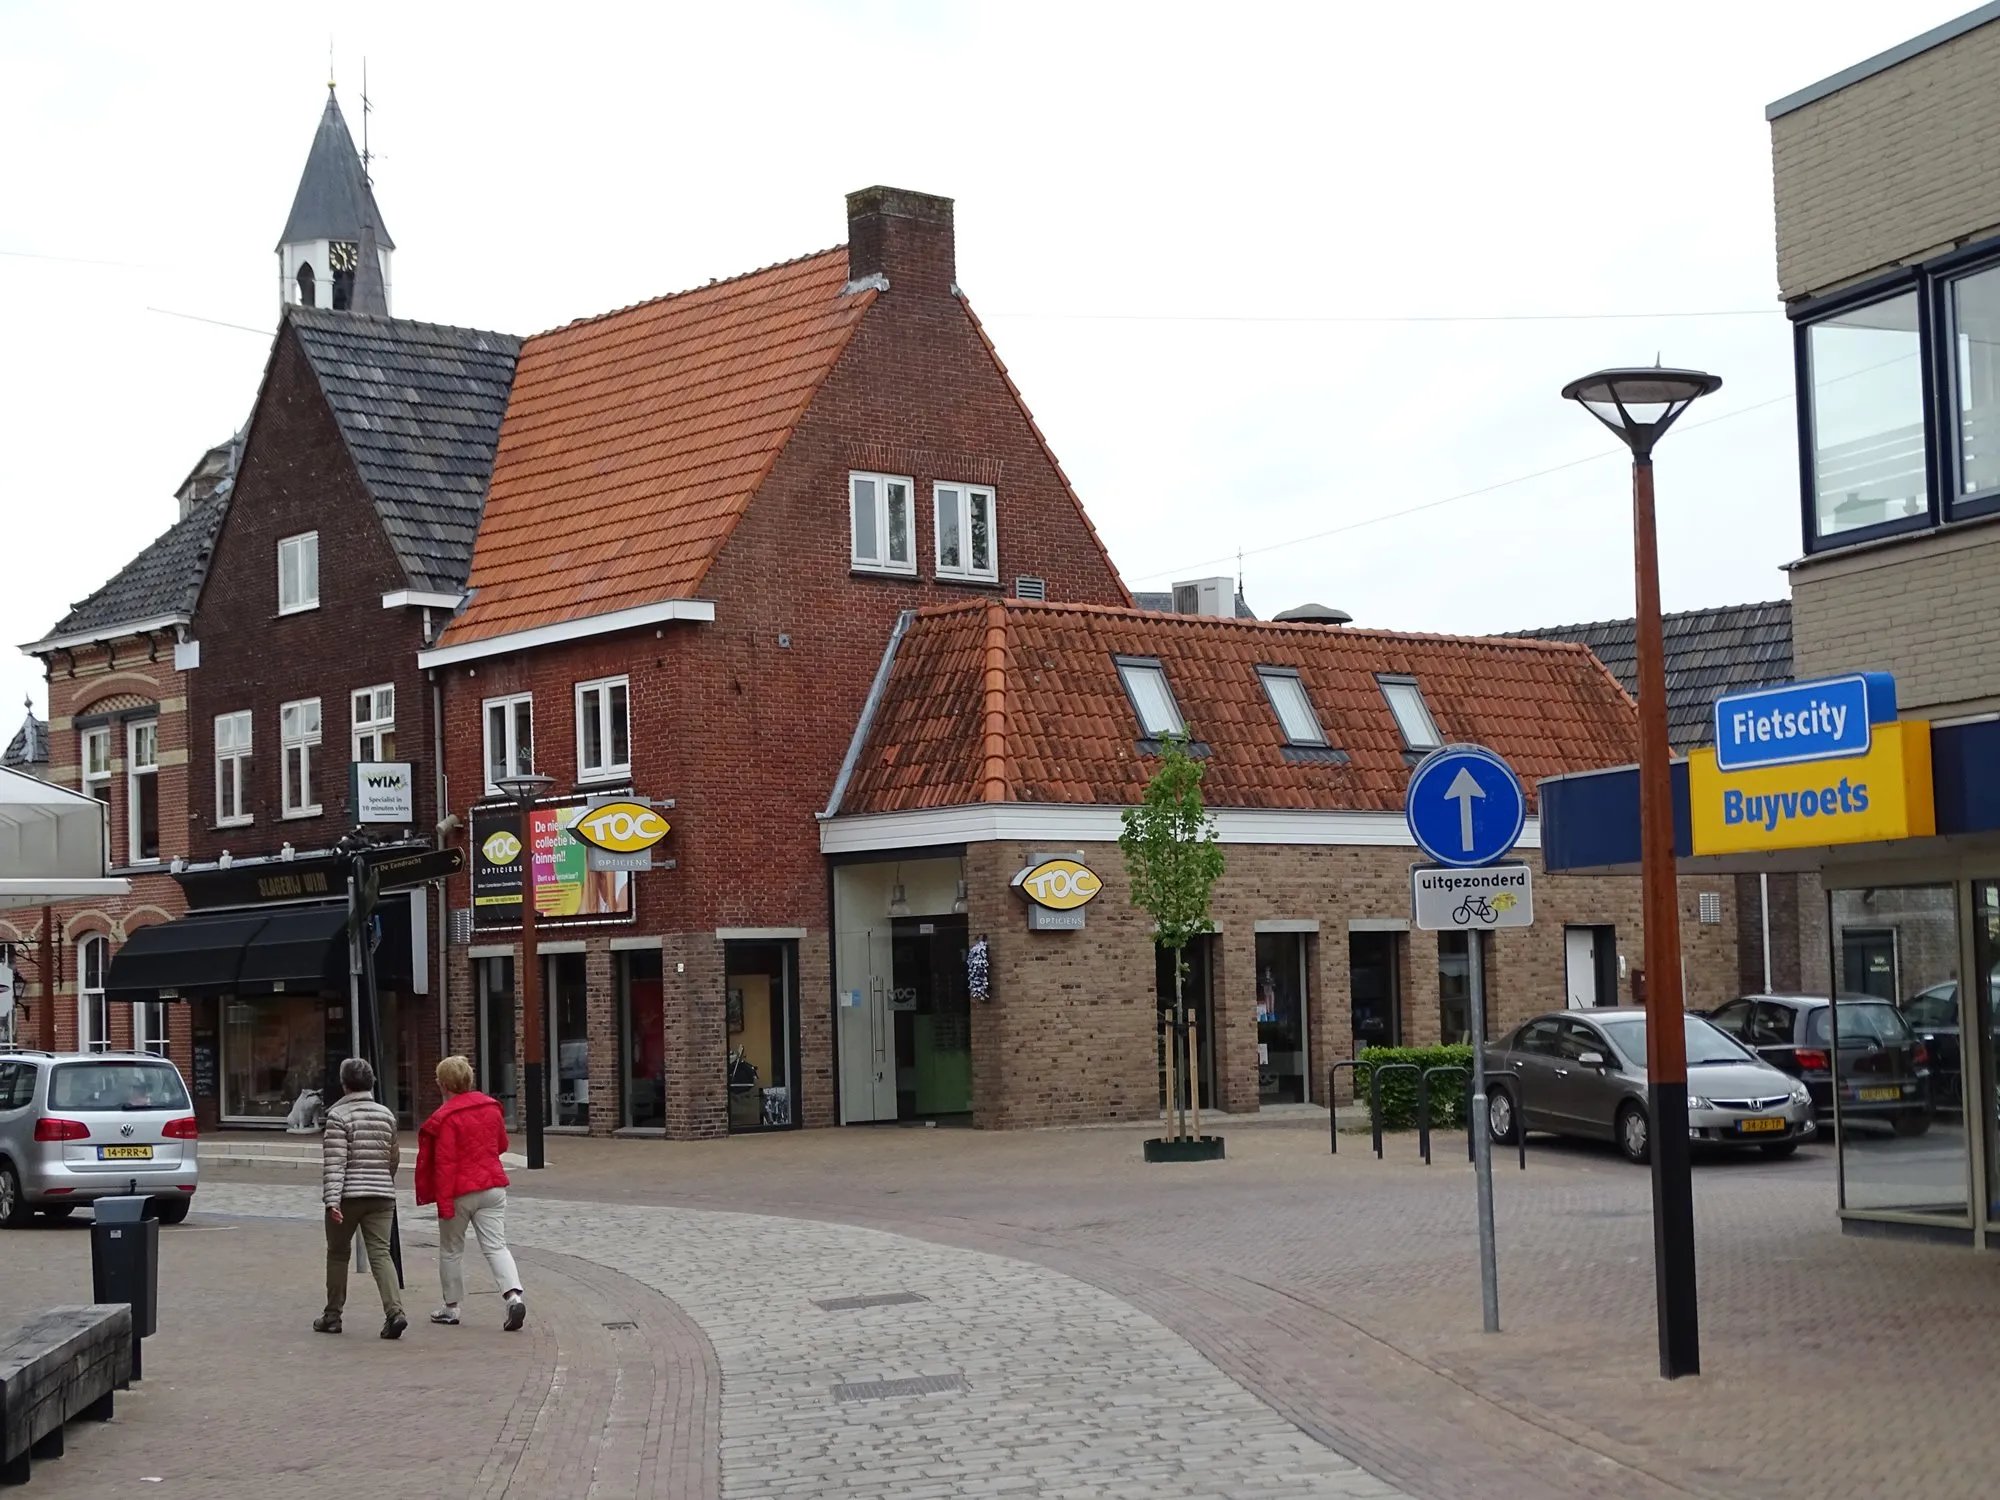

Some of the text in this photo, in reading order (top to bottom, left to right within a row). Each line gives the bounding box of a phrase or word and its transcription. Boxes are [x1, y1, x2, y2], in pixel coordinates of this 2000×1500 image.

[1733, 701, 1847, 745] Fietscity
[368, 775, 401, 788] WIM
[368, 796, 395, 804] Specialist
[1723, 776, 1869, 832] Buyvoets
[535, 821, 546, 833] De
[583, 812, 663, 841] TOC
[483, 837, 520, 859] TOC
[535, 835, 577, 849] collectie is
[390, 857, 422, 869] Eendracht
[535, 850, 566, 864] binnen!!
[598, 859, 648, 867] OPTICIENS
[481, 865, 523, 875] OPTICIENS
[258, 872, 328, 897] SLAGERIJ WIM
[1027, 869, 1096, 898] TOC
[1422, 873, 1525, 892] uitgezonderd
[1040, 917, 1082, 925] OPTICIENS
[107, 1148, 148, 1157] 14-PRR-4
